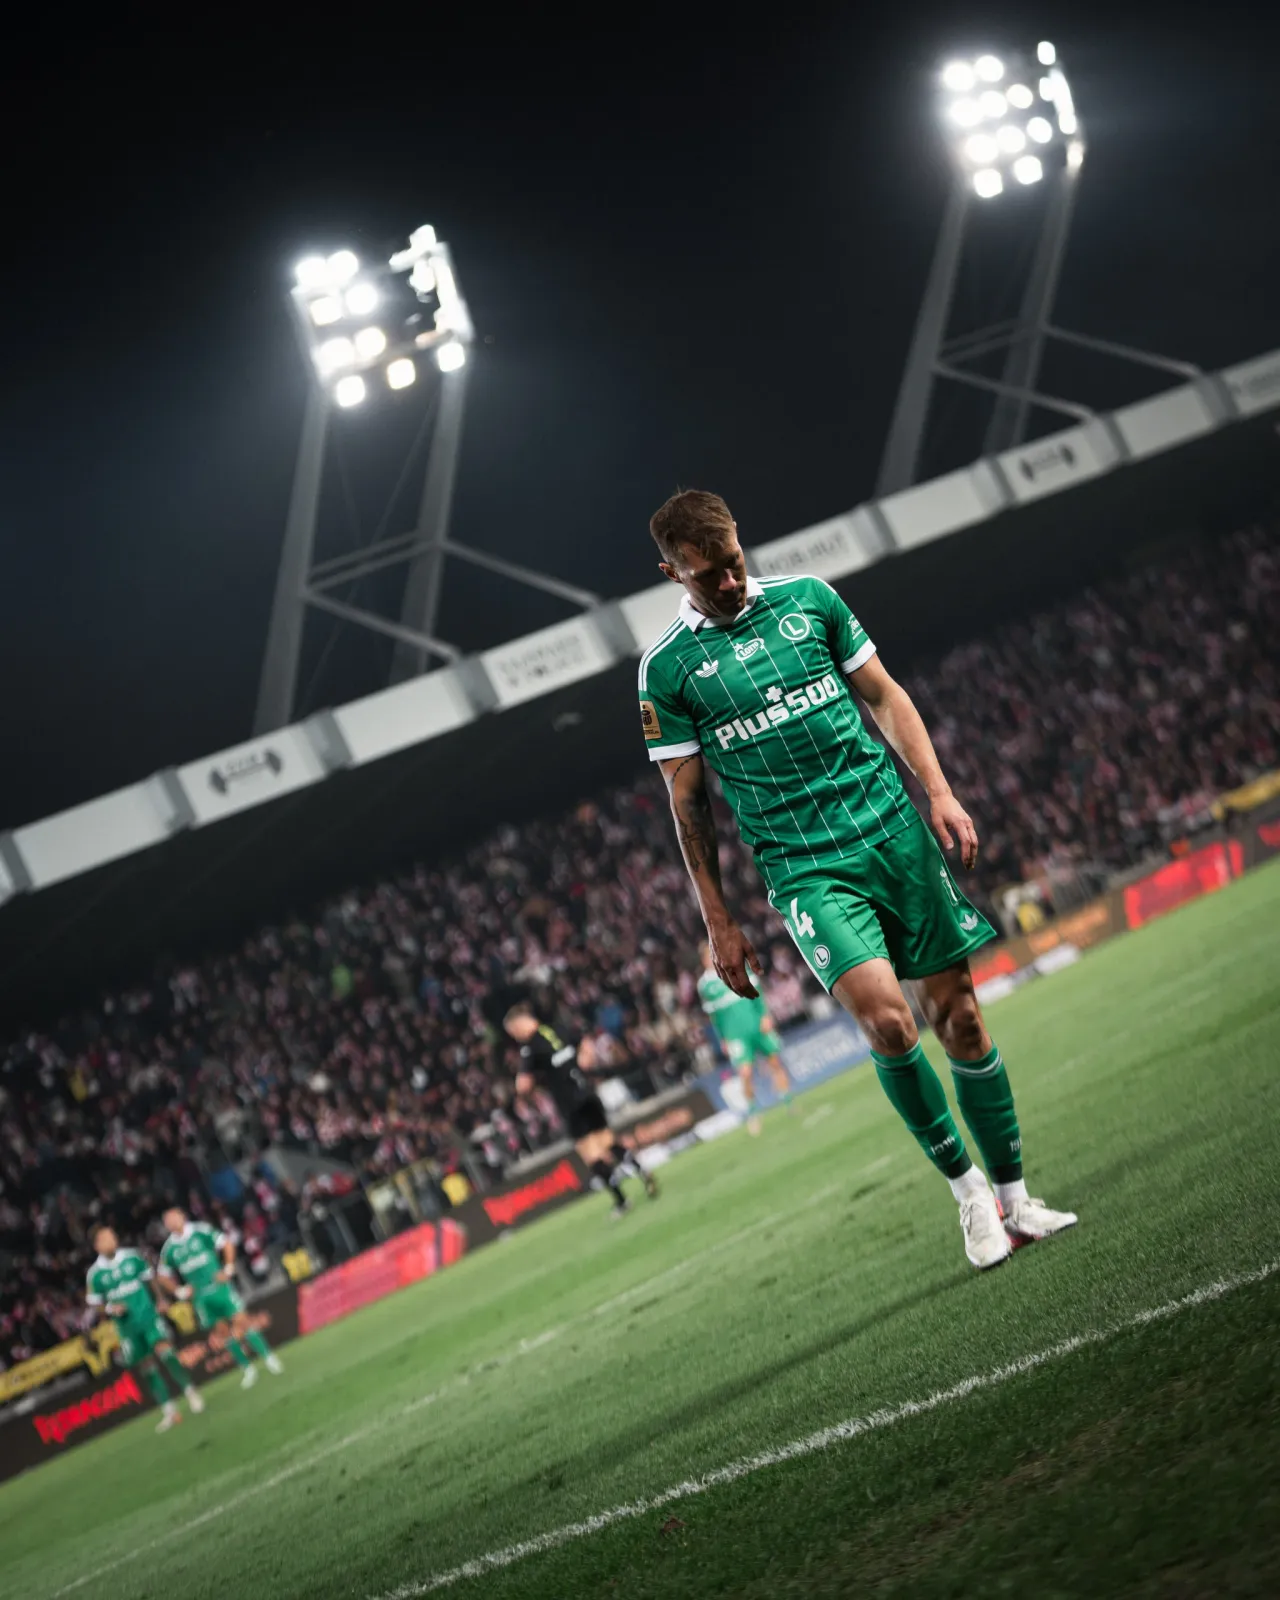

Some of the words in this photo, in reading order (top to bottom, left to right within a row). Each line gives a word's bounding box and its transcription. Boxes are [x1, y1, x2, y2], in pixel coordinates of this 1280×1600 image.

[784, 620, 804, 636] L
[714, 673, 839, 750] Plus500
[790, 897, 816, 939] 4
